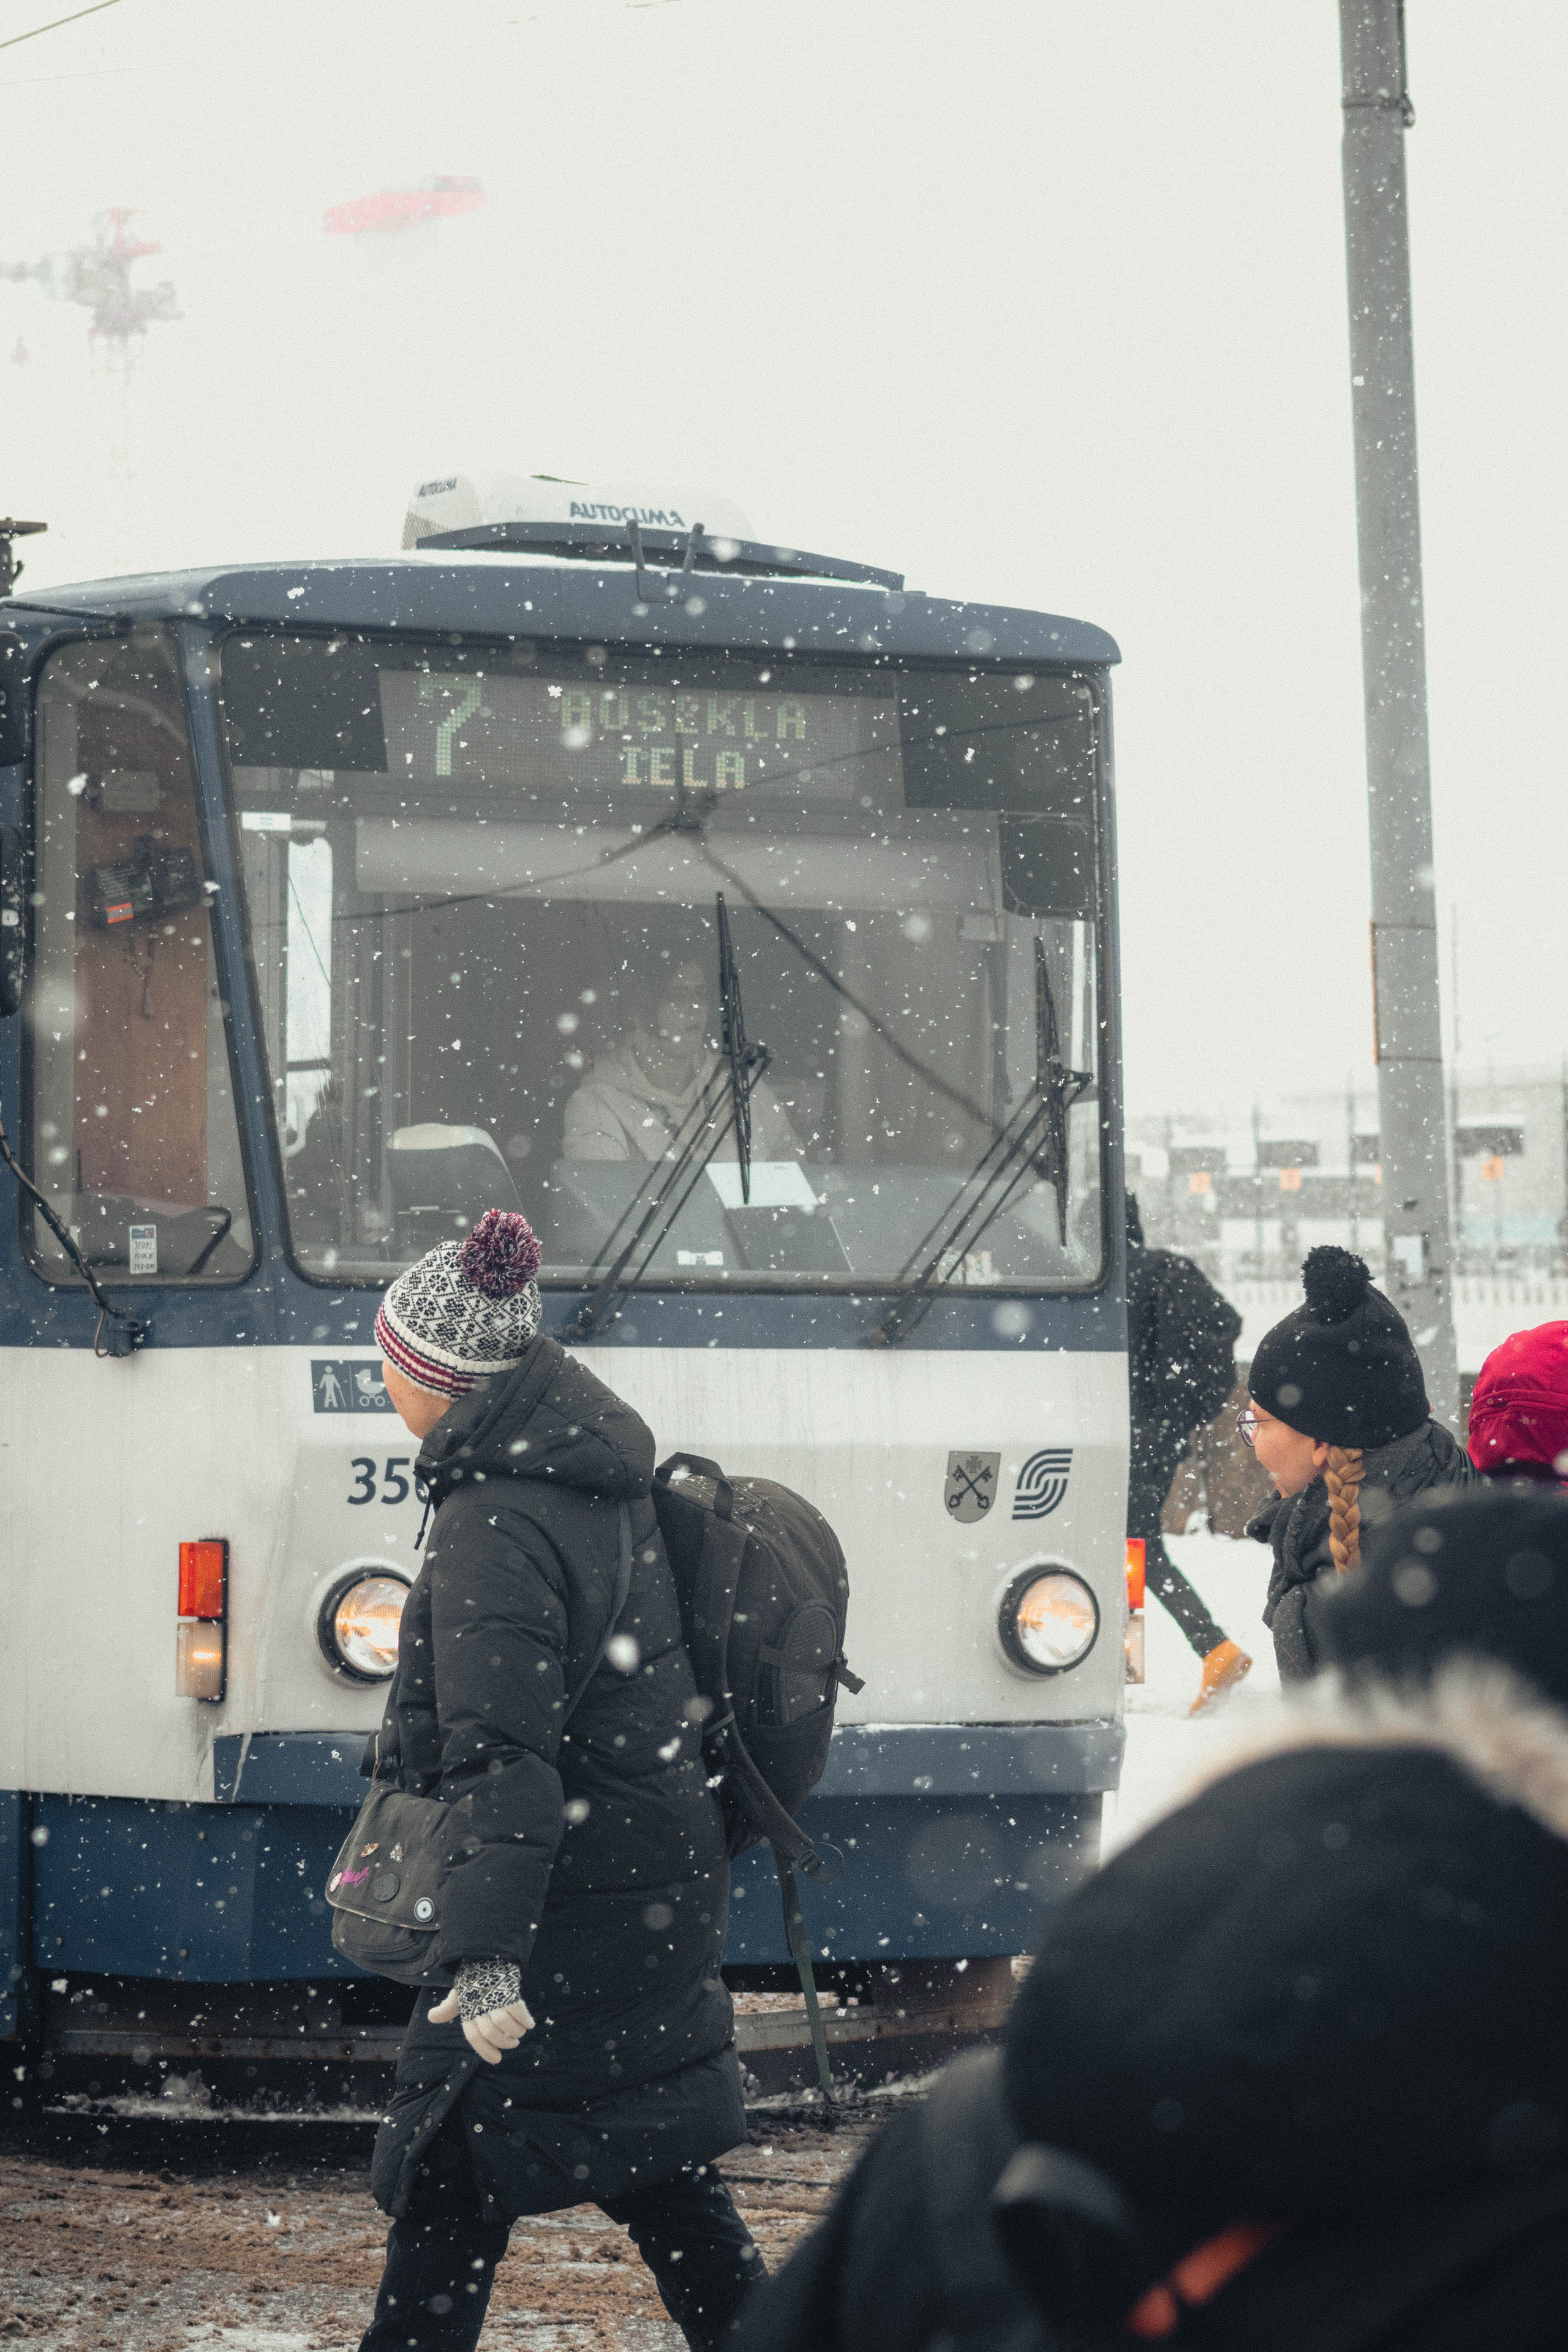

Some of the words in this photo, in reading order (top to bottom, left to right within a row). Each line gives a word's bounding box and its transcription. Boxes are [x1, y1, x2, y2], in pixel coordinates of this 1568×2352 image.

[570, 502, 685, 527] AUTOCLIMA
[419, 676, 481, 776] 7
[622, 747, 745, 788] IELA
